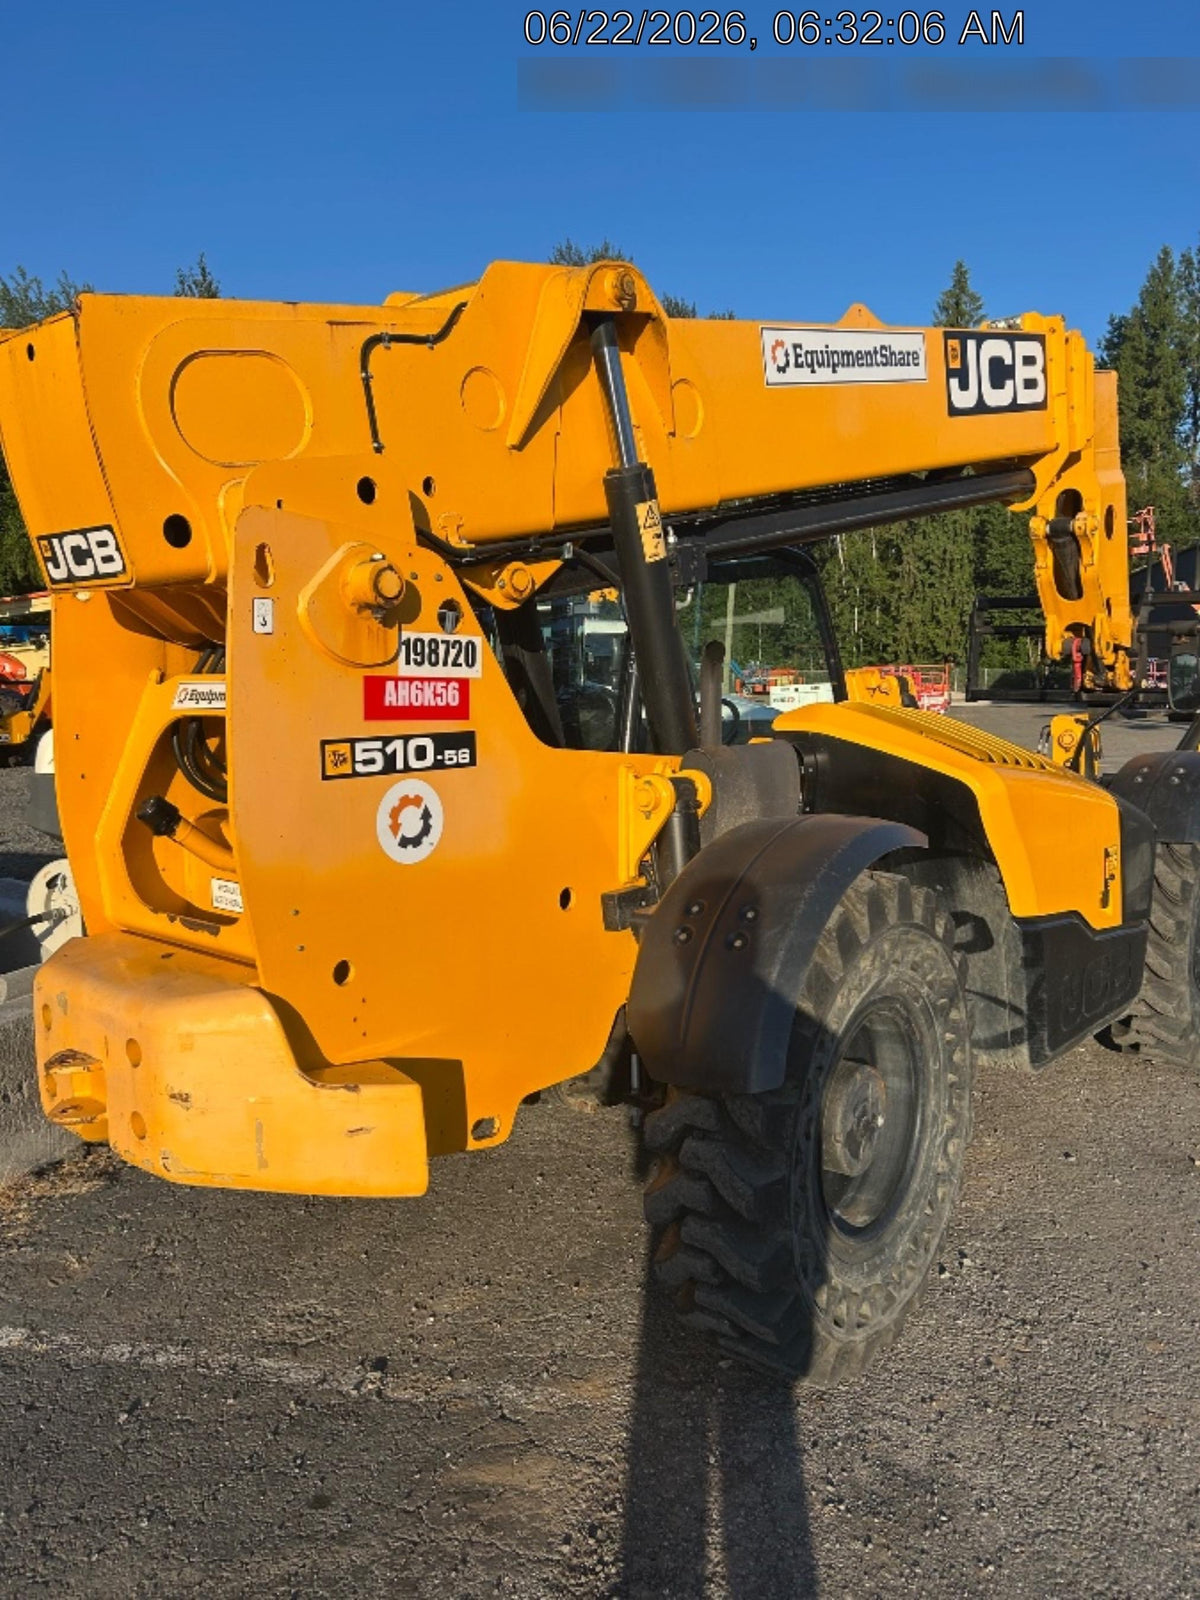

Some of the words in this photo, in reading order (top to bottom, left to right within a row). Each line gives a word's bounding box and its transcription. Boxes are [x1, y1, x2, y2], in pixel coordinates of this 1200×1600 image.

[791, 343, 920, 374] EquipmentShare
[949, 339, 1046, 408] JCB
[46, 529, 124, 580] JCB
[401, 637, 477, 668] 198720
[384, 680, 460, 706] AH6K56
